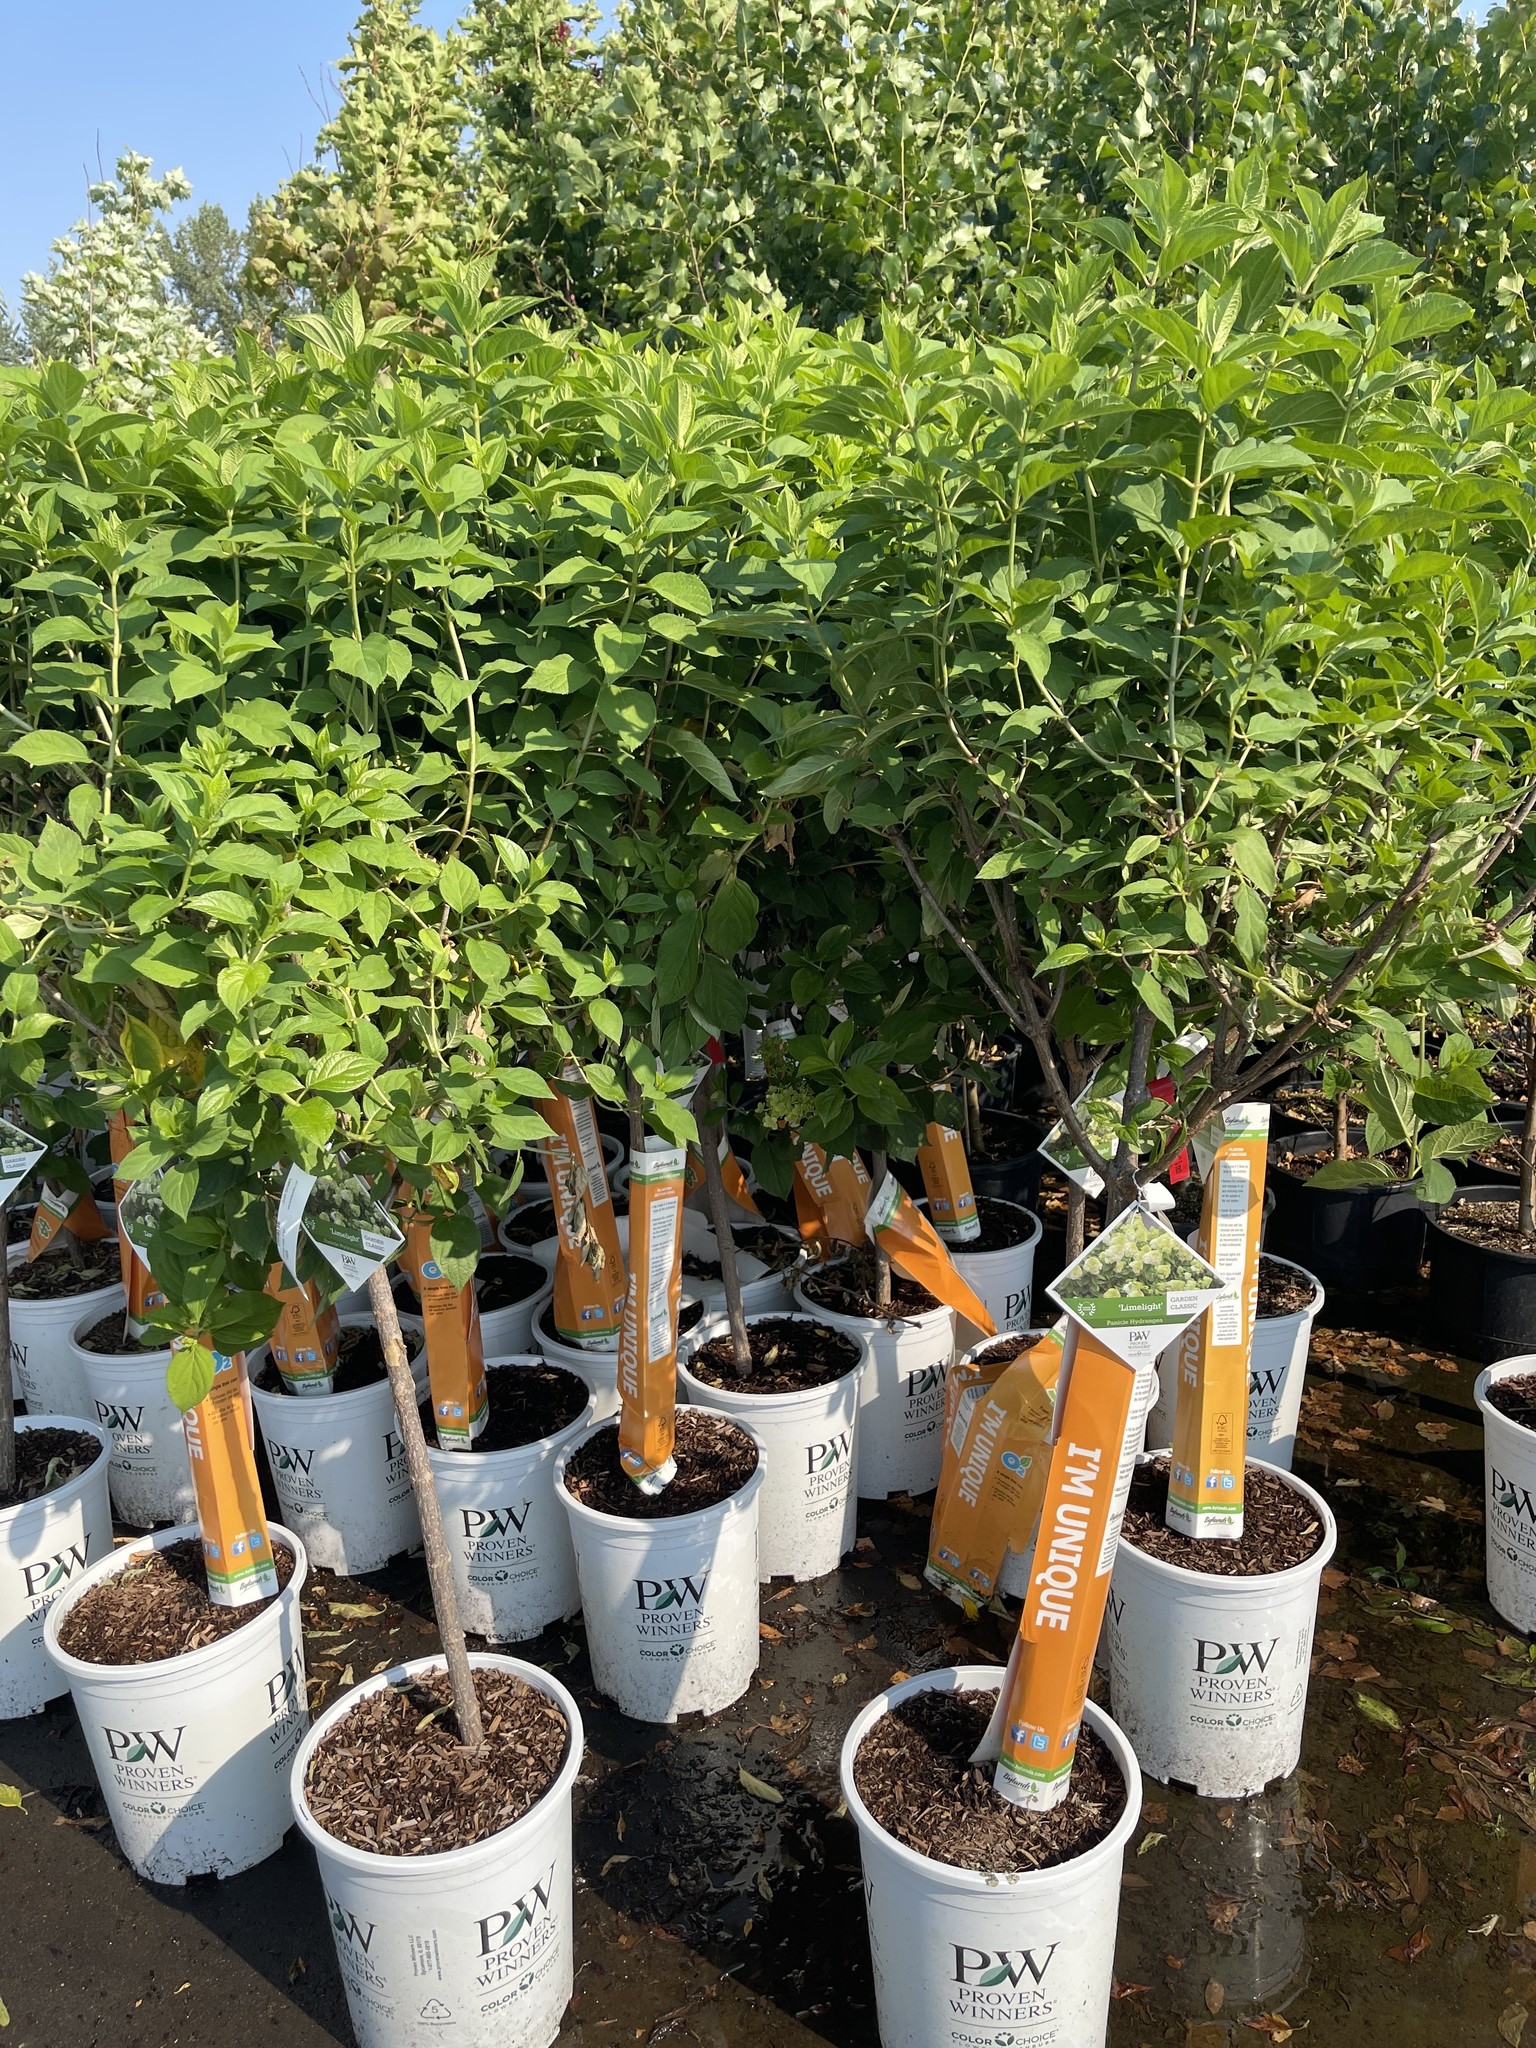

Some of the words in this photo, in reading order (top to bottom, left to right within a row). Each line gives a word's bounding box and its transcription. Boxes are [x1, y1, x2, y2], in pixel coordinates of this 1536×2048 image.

[802, 1142, 833, 1198] NIQUE
[852, 1152, 869, 1185] QUE
[1118, 1302, 1163, 1312] 'Limelight'
[1171, 1295, 1198, 1303] GARDEN
[1130, 1318, 1163, 1326] Hydrangea
[1129, 1331, 1150, 1341] PW
[621, 1310, 638, 1399] UNIQUE
[905, 1353, 950, 1398] PW
[1250, 1366, 1286, 1397] W
[94, 1399, 145, 1432] PW
[903, 1398, 946, 1420] WINNER
[980, 1400, 1008, 1437] I'M
[112, 1433, 144, 1443] OVEN
[183, 1406, 204, 1461] QUE
[266, 1438, 315, 1475] PW
[804, 1424, 855, 1476] PW
[275, 1468, 315, 1488] PROVEN
[958, 1431, 995, 1508] UNIQUE
[1061, 1442, 1101, 1498] I'M
[388, 1489, 410, 1504] COLOR
[459, 1501, 533, 1538] PW
[805, 1506, 829, 1519] COLOR
[1490, 1509, 1536, 1551] WINNER
[463, 1545, 533, 1563] WINNERS
[468, 1535, 527, 1551] PROVEN
[19, 1532, 92, 1599] PW
[467, 1574, 494, 1582] COLOR
[509, 1567, 538, 1580] CHOICE
[1035, 1503, 1091, 1632] UNIQUE
[31, 1587, 65, 1610] PRO
[632, 1569, 711, 1611] PW
[641, 1606, 704, 1624] PROVEN
[636, 1617, 711, 1636] WINNERS
[640, 1649, 669, 1658] COLOR
[685, 1641, 715, 1655] CHOICE
[1192, 1636, 1281, 1676] PW
[1198, 1676, 1268, 1691] PROVEN
[1189, 1687, 1273, 1704] WINNERS
[1018, 1719, 1036, 1731] Follow
[1037, 1725, 1045, 1733] Us
[1190, 1715, 1224, 1726] COLOR
[1242, 1714, 1273, 1726] CHOICE
[101, 1725, 188, 1764] PW
[117, 1764, 184, 1779] PROVEN
[1003, 1772, 1030, 1790] Bylands
[114, 1774, 194, 1792] WINNERS
[122, 1801, 150, 1813] COLOR
[167, 1802, 204, 1814] CHOICE
[474, 1858, 557, 1958] PW
[485, 1909, 551, 1971] PROVEN
[475, 1921, 557, 1988] WINNERS
[949, 1941, 1061, 1989] PW
[481, 1990, 517, 2012] COLOR
[958, 1987, 1046, 2006] PROVEN
[949, 1999, 1053, 2021] WINNERS
[951, 2031, 992, 2046] COLOR
[1015, 2030, 1057, 2046] CHOICE
